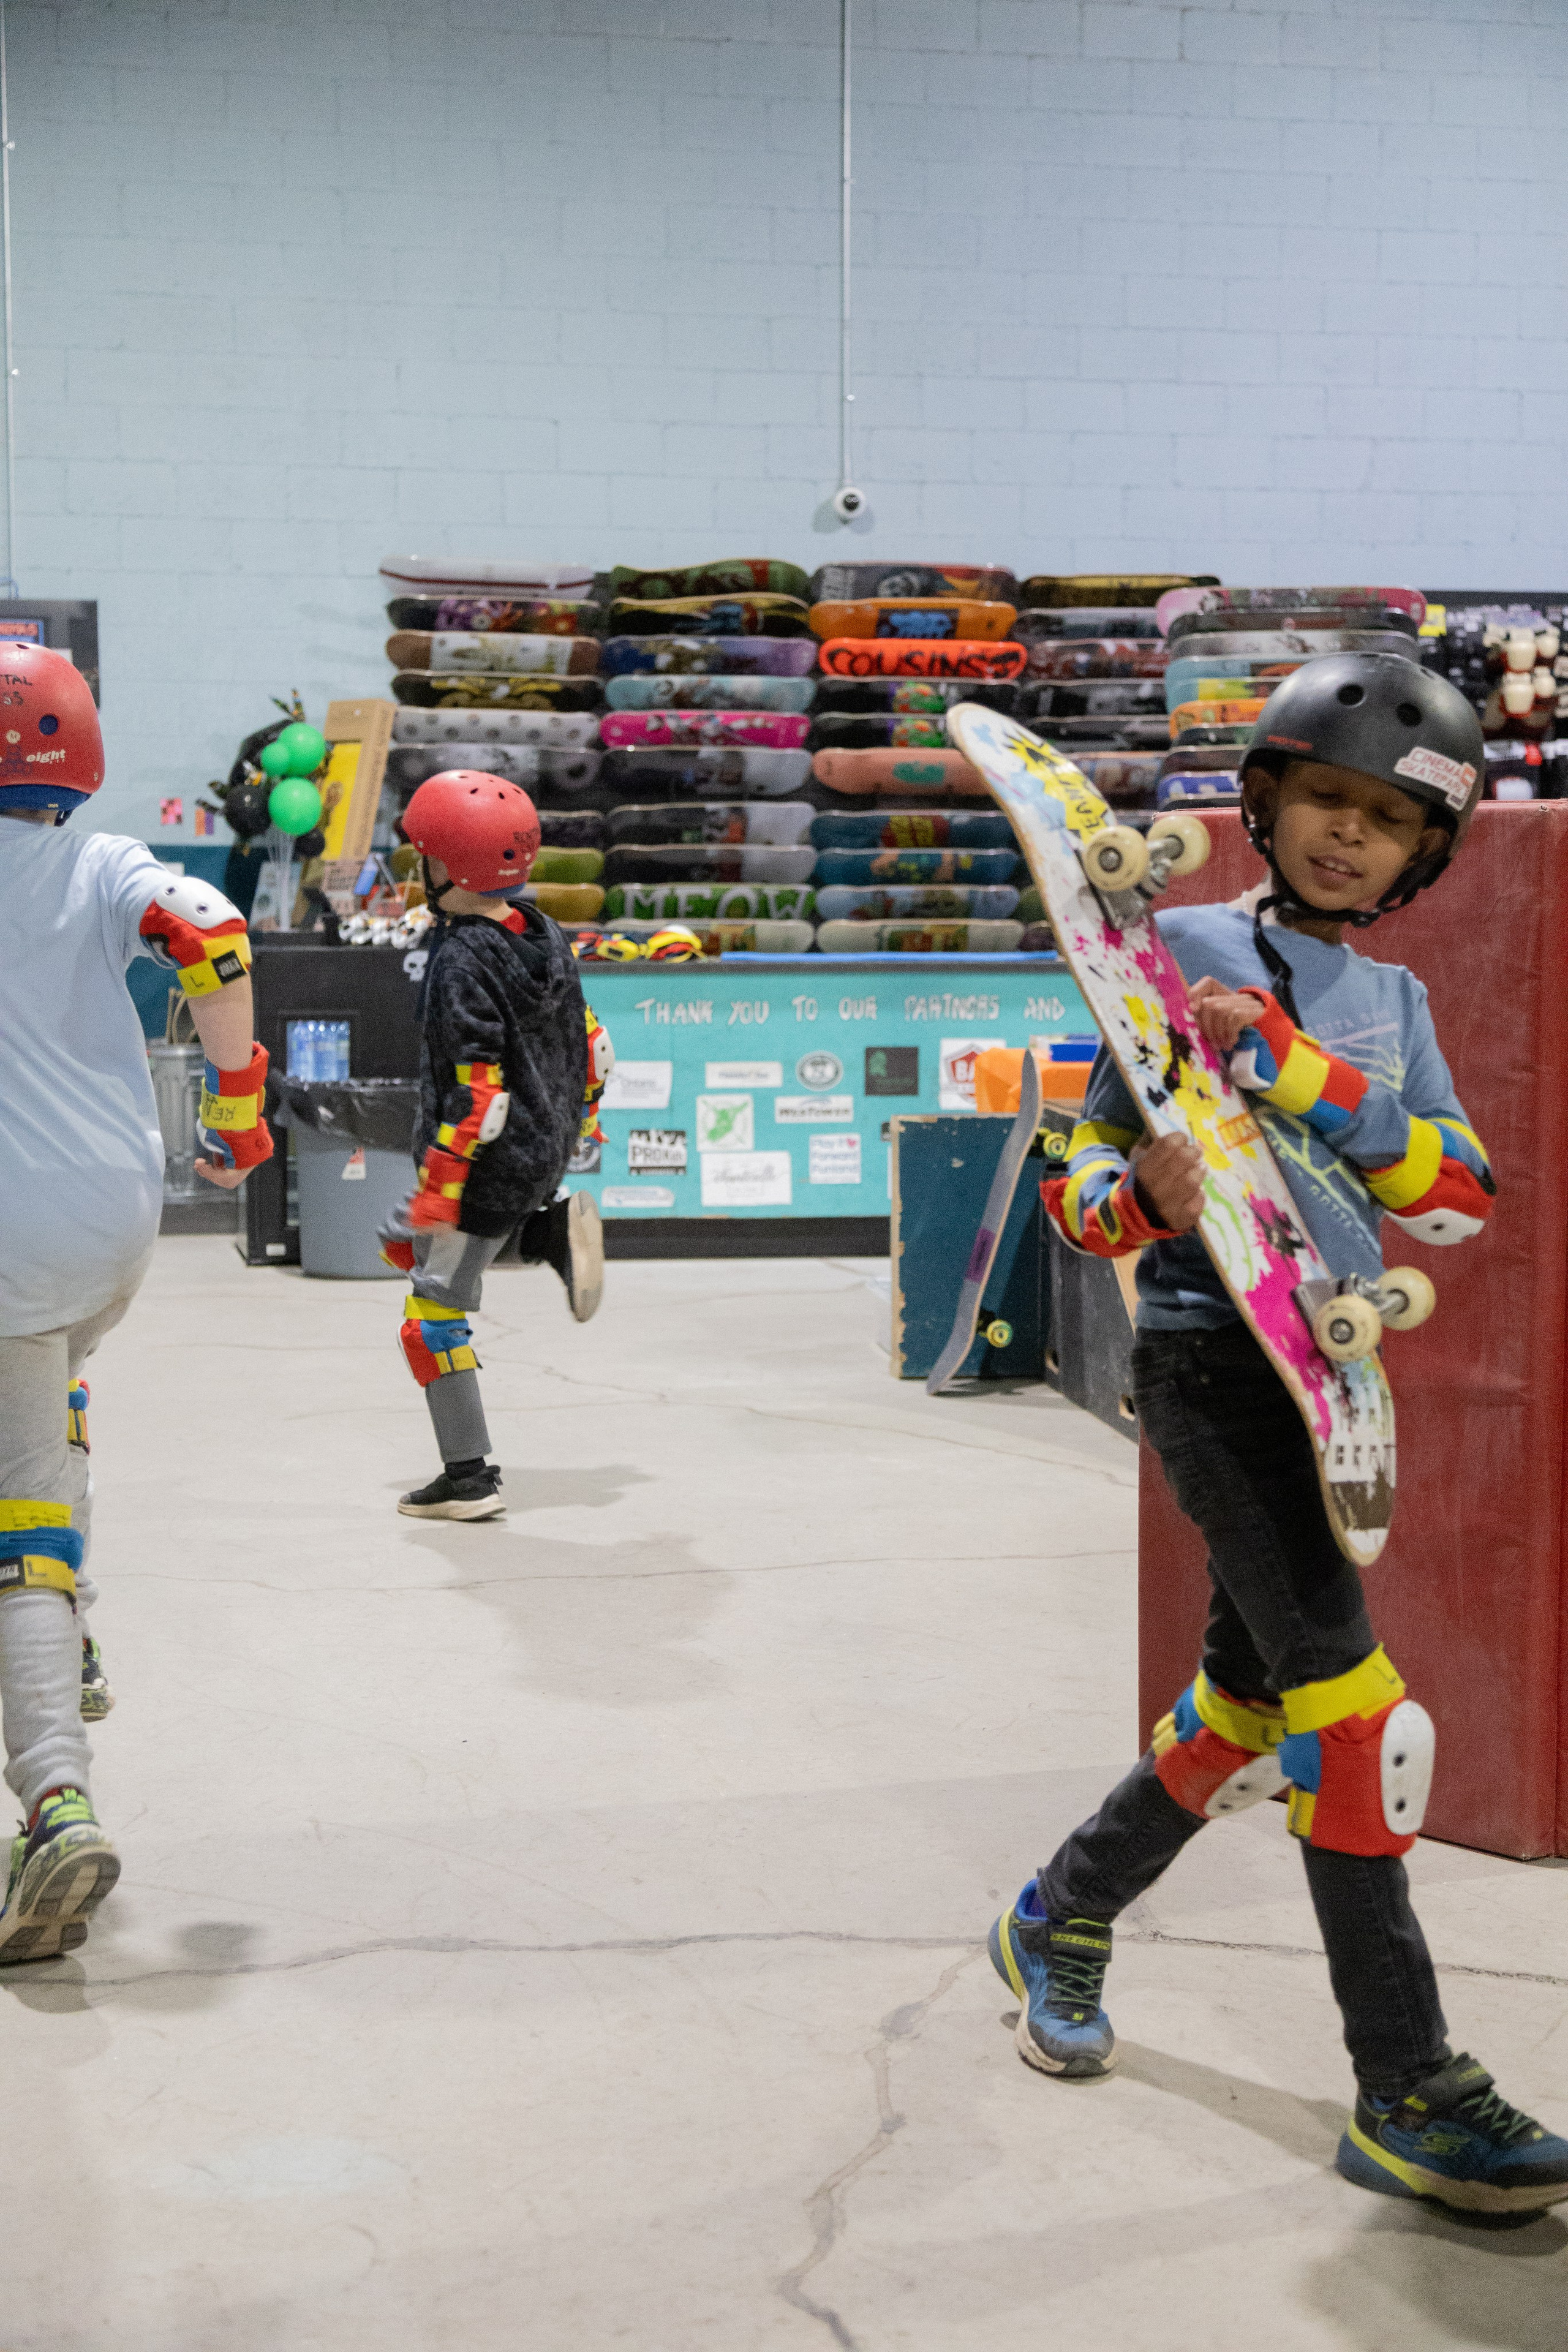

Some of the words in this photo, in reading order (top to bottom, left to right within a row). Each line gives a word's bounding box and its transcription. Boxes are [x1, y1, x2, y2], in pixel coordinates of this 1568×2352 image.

[827, 647, 987, 676] COUSINS
[26, 749, 66, 764] eight
[1411, 749, 1462, 777] CINEMA
[624, 888, 810, 919] MEOW
[635, 998, 714, 1025] THANK
[728, 1000, 770, 1025] YOU
[792, 995, 818, 1022] TO
[839, 995, 878, 1021] OUR
[1023, 995, 1066, 1022] AND
